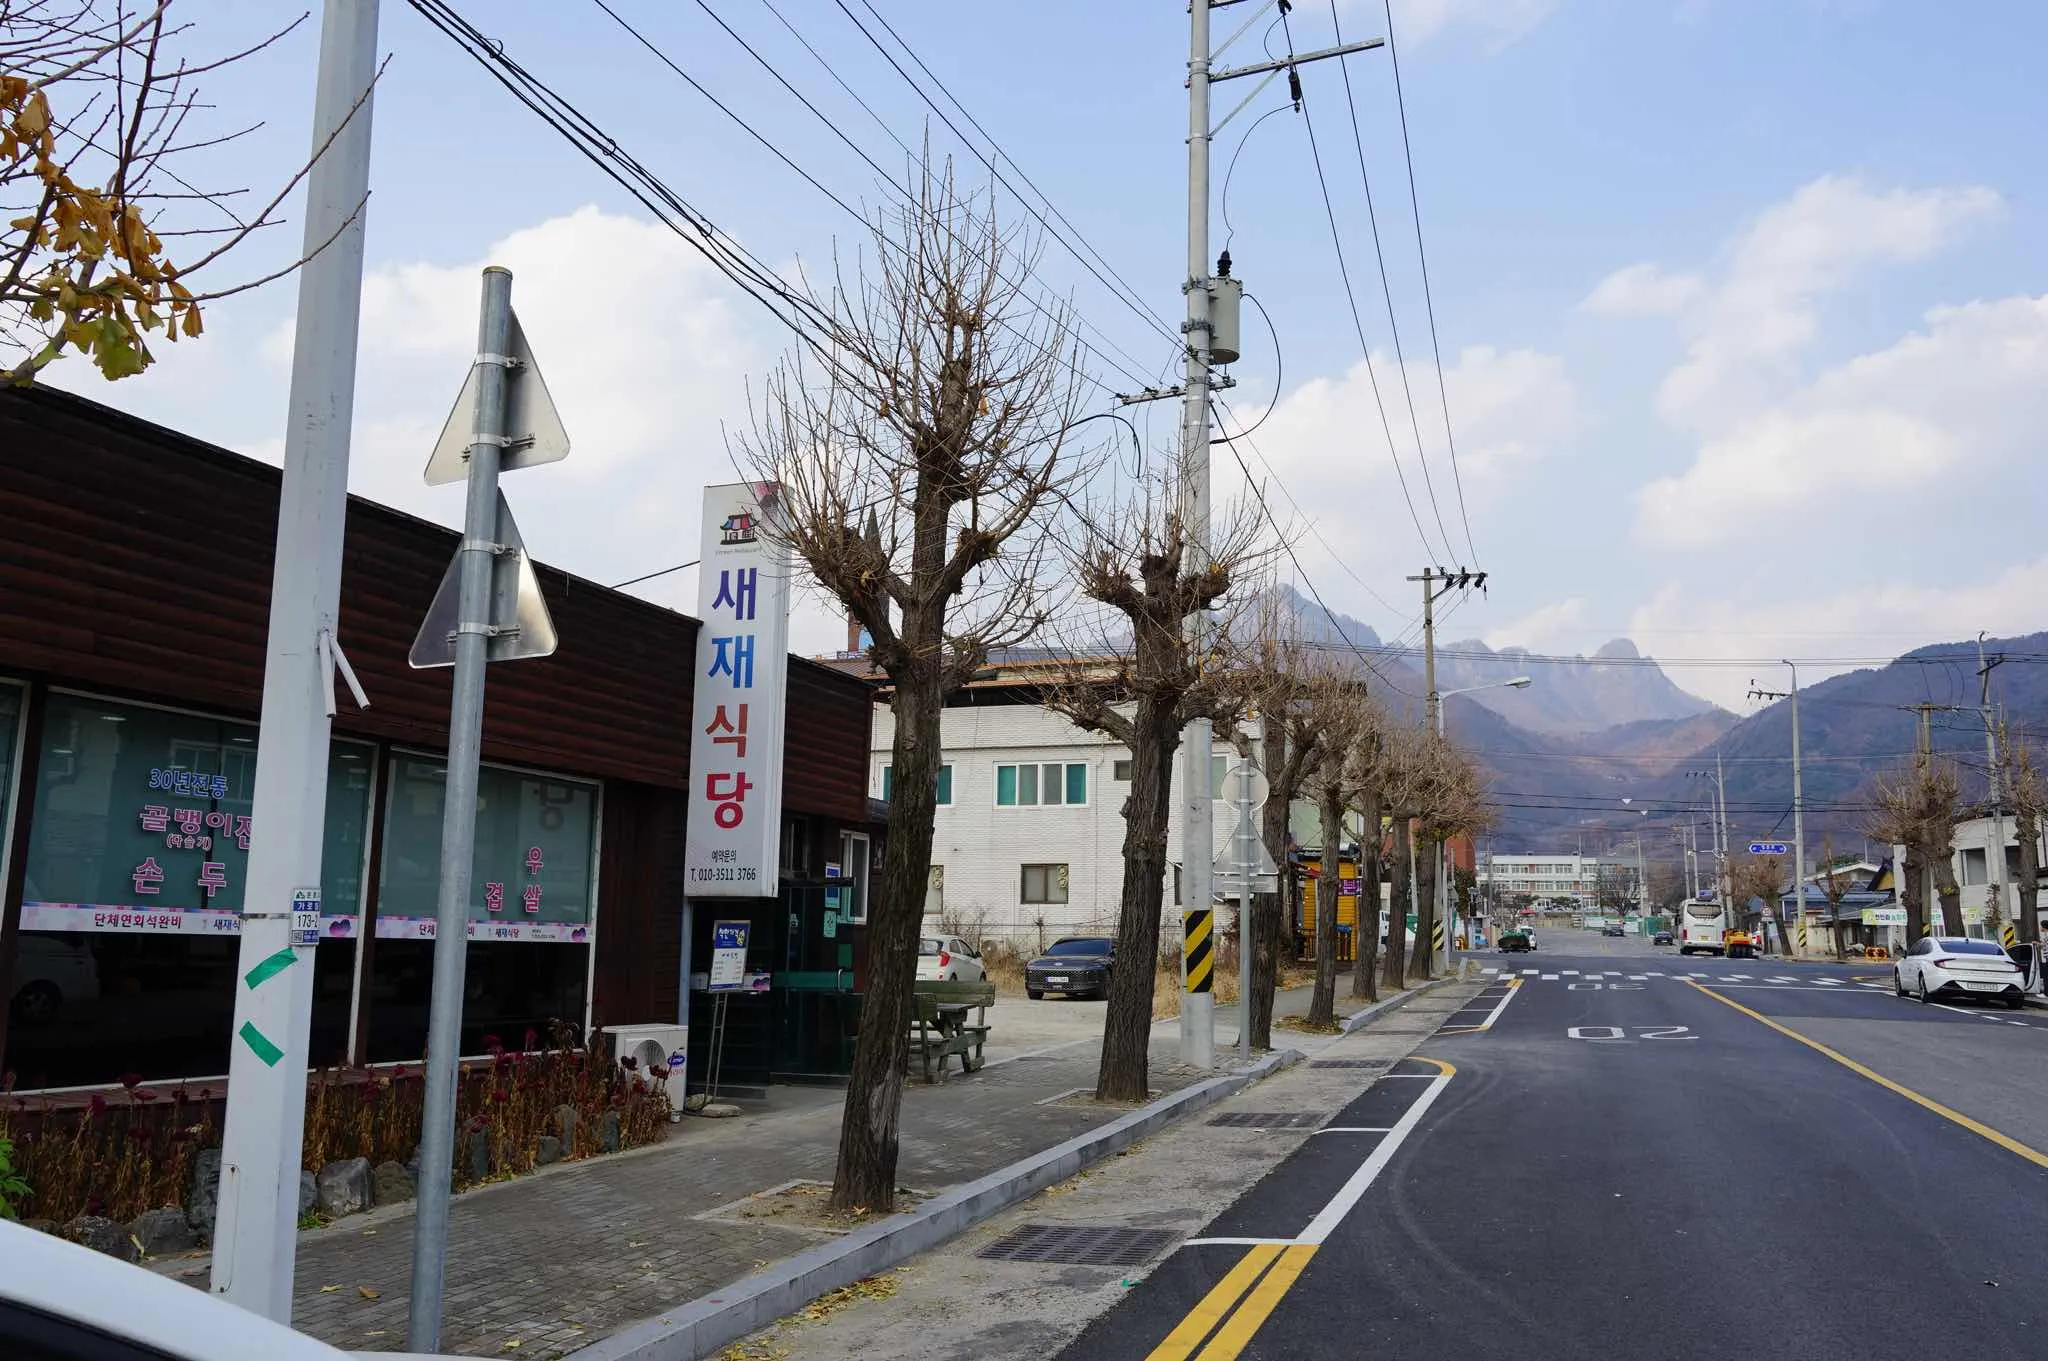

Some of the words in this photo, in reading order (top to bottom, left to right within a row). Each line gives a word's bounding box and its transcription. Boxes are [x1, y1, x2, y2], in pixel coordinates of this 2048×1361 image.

[704, 567, 758, 829] 새재식당
[149, 768, 229, 800] 30년전통
[711, 849, 737, 864] 예약문의
[737, 867, 756, 881] 3766
[94, 912, 182, 929] 단체연회석완비
